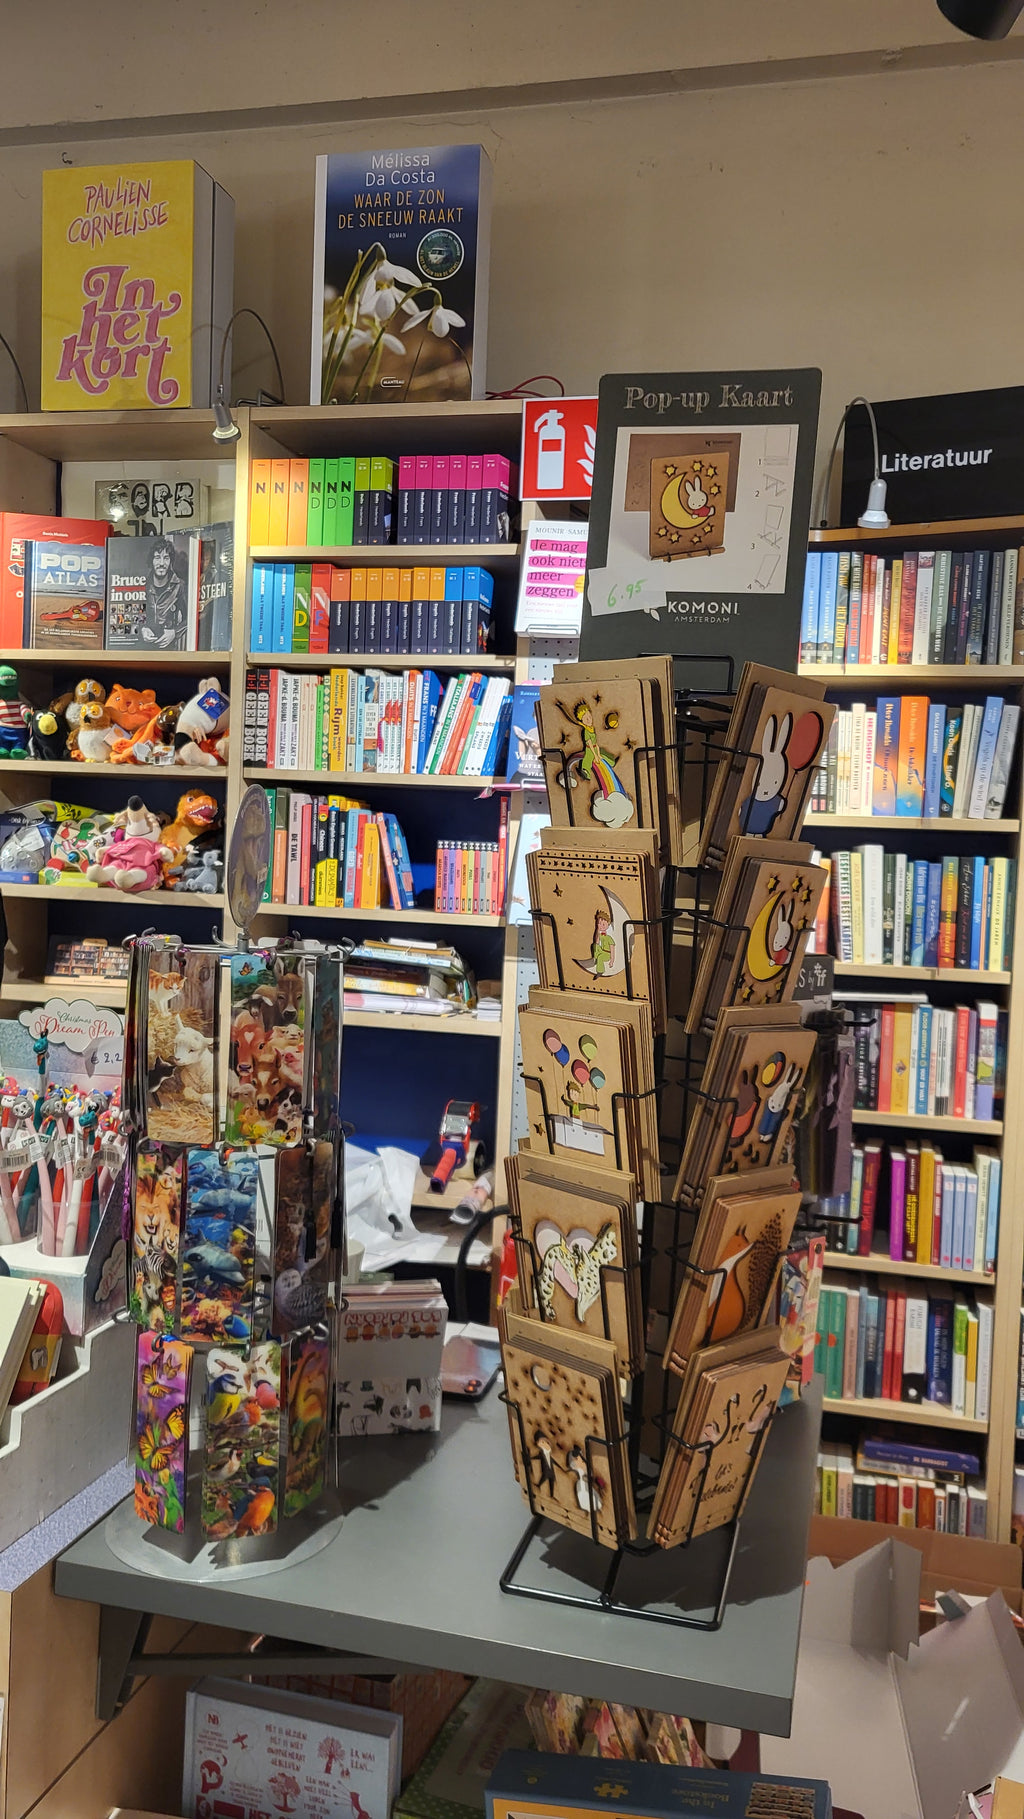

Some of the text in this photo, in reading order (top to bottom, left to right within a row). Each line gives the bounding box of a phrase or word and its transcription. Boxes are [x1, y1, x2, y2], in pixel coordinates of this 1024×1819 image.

[372, 153, 430, 169] Mélissa
[366, 169, 435, 186] Da Costa
[354, 189, 444, 208] WAAR DE ZON
[68, 201, 168, 248] CORNELISSE
[338, 208, 464, 229] DE SNEEUW RAAKT
[84, 266, 155, 312] In
[77, 292, 181, 347] het
[56, 335, 179, 405] kort
[624, 384, 794, 414] Pop-up Kaart
[881, 449, 992, 473] Literatuur
[256, 483, 266, 493] N
[275, 483, 284, 493] N
[294, 481, 304, 493] N
[312, 482, 321, 493] N
[327, 482, 337, 493] N
[341, 481, 351, 492] N
[311, 497, 320, 509] D
[327, 498, 336, 509] D
[341, 497, 350, 508] D
[533, 539, 579, 554] Je mag
[40, 553, 101, 572] POP
[531, 554, 555, 566] ook
[43, 572, 98, 587] ATLAS
[111, 574, 146, 587] Bruce
[530, 571, 564, 581] meer
[111, 588, 124, 602] in
[200, 582, 227, 598] STEEN
[527, 586, 574, 598] zeggen
[607, 580, 646, 608] 6.95
[668, 601, 739, 615] KOMONI
[835, 606, 846, 648] HET ZUIDEN
[257, 692, 269, 726] GEEN
[447, 686, 462, 718] ITALIAANS
[244, 692, 256, 761] GEEN BOEK
[331, 708, 344, 736] Rijm
[255, 728, 268, 761] BOEK
[866, 718, 874, 764] HEADSHOT
[976, 742, 992, 801] Vogels op de wind
[290, 833, 298, 862] DE TAWL
[328, 865, 336, 897] DUMMIES
[840, 854, 851, 961] DESPENTES BESTE KLOOTZAK
[35, 1014, 115, 1039] Dream Pen
[57, 1011, 93, 1024] Christmas
[350, 1748, 360, 1758] ER
